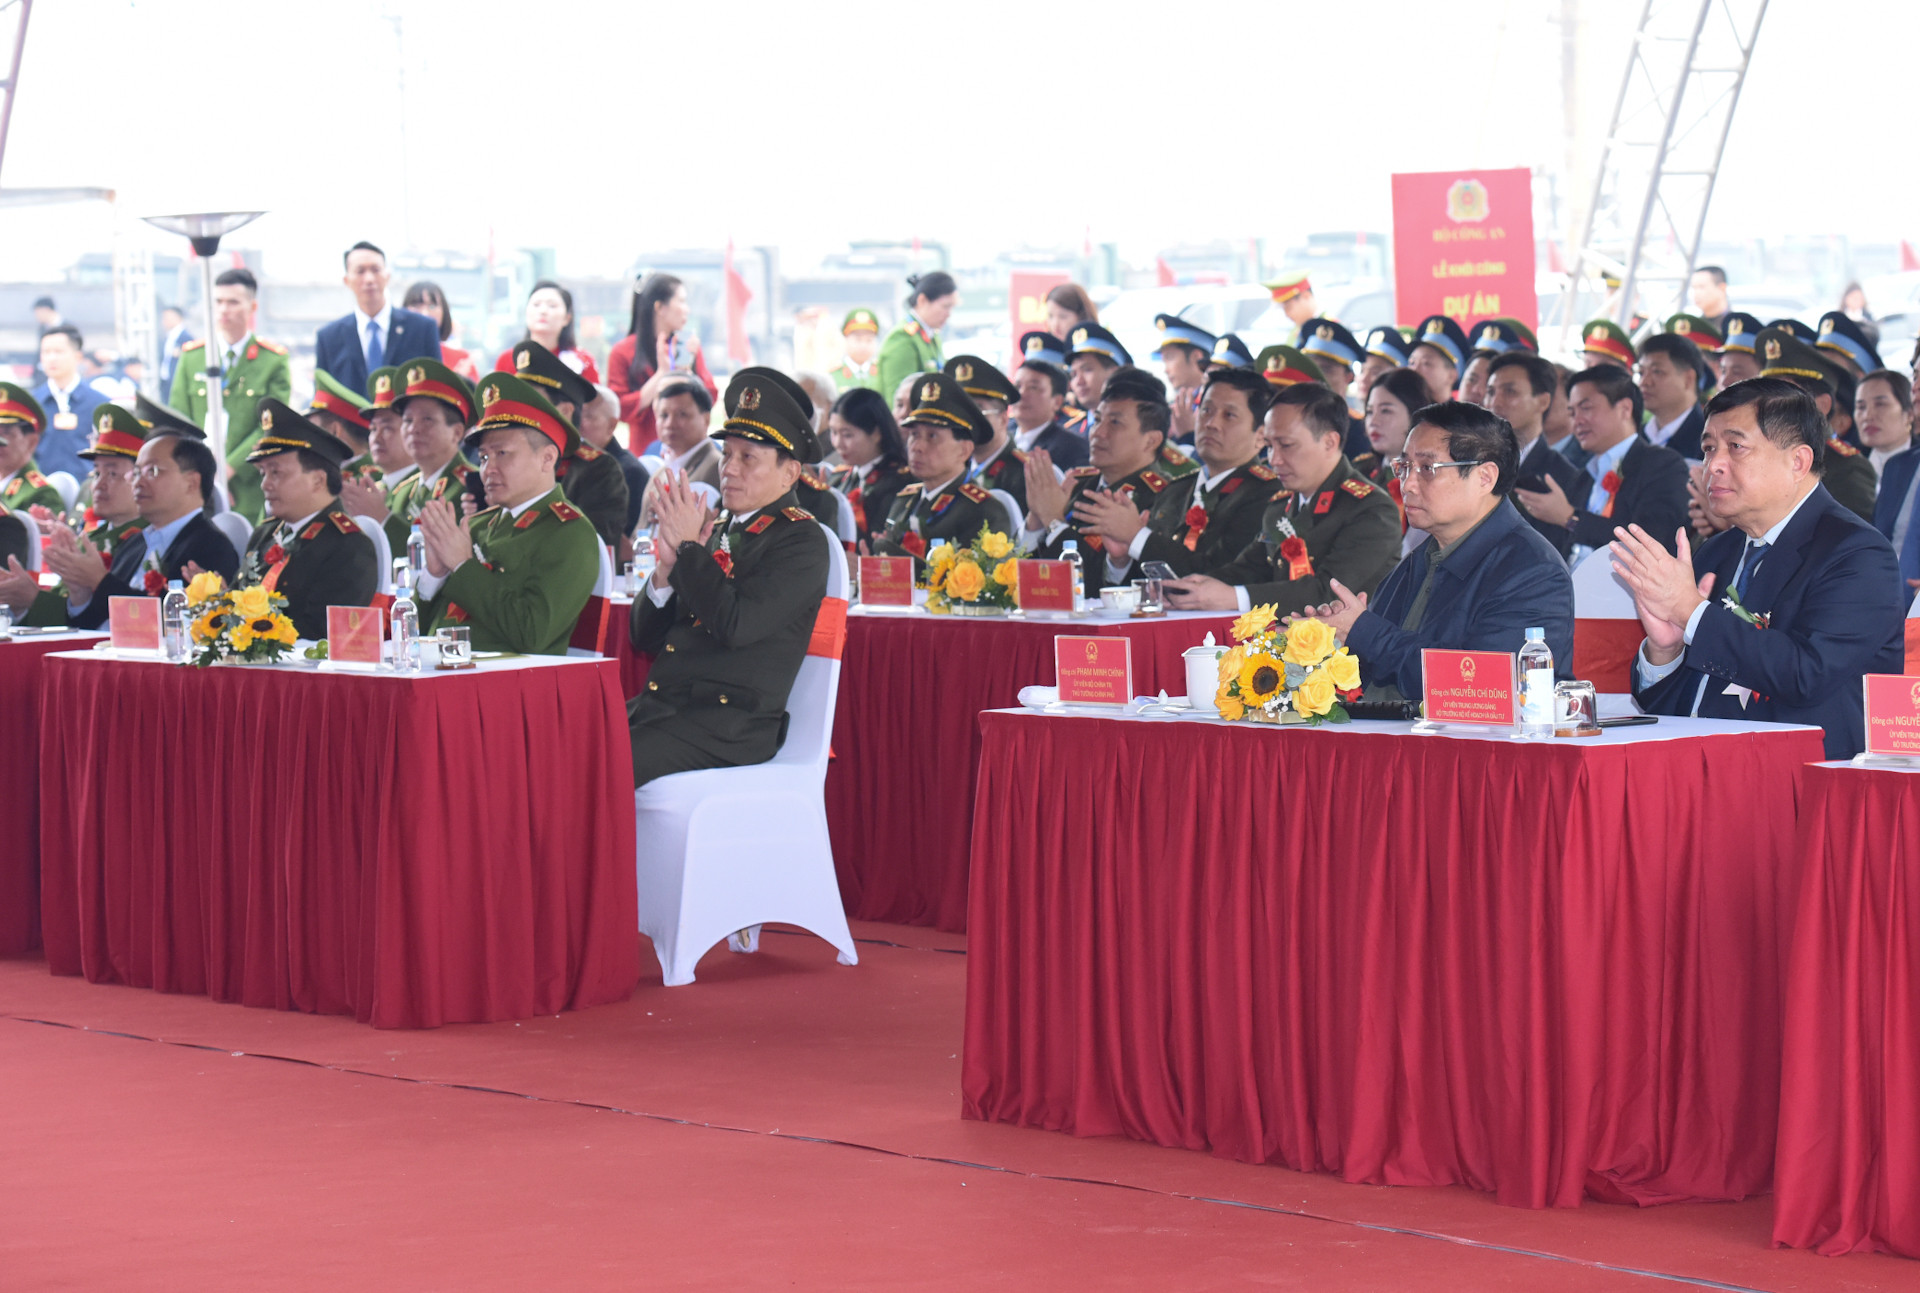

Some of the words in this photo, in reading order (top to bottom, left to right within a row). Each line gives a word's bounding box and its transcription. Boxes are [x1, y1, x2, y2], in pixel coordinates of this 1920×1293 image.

[1443, 293, 1470, 322] DỰ
[1472, 290, 1500, 316] ÁN
[1076, 667, 1092, 677] PHẠM
[1092, 668, 1107, 676] MINH
[1108, 666, 1125, 677] CHÍNH
[1450, 685, 1476, 698] NGUYỄN
[1477, 687, 1488, 698] CHÍ
[1488, 687, 1508, 699] DŨNG
[1872, 716, 1886, 726] Đồng
[1896, 713, 1920, 726] NGUYỄ
